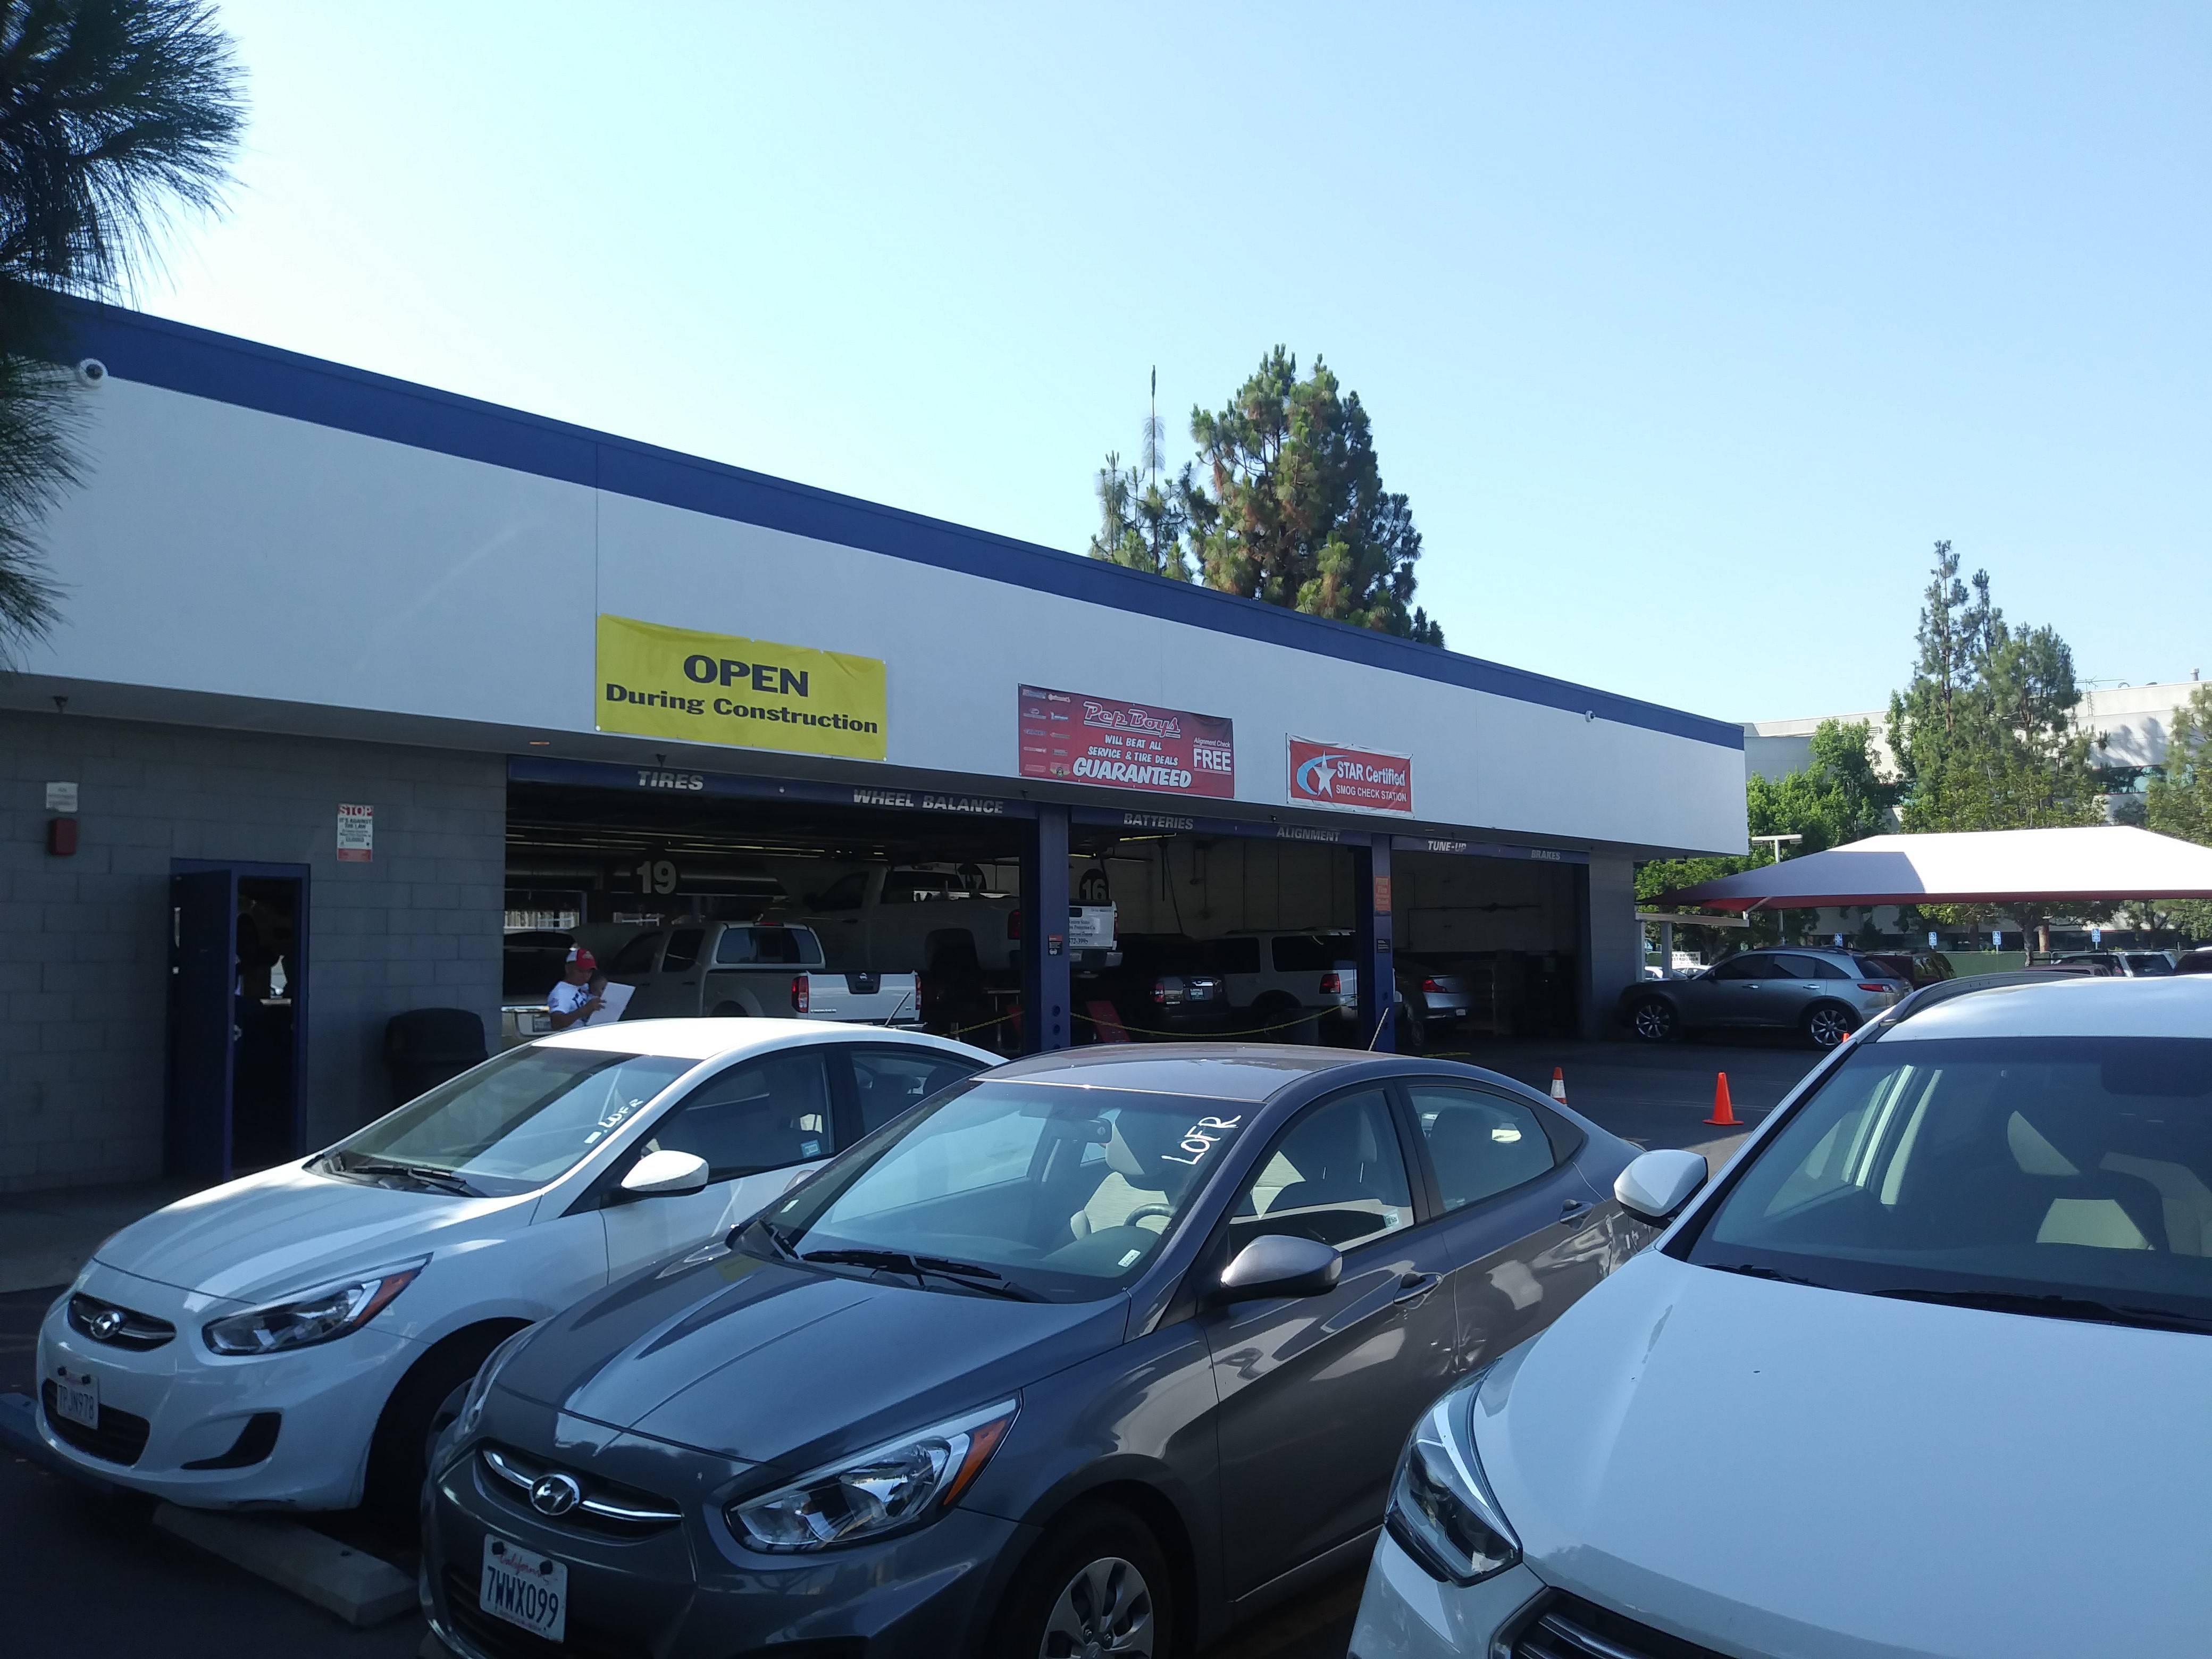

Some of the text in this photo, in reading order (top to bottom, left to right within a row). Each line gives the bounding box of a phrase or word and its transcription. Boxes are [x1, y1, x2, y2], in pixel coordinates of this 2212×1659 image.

[684, 655, 808, 697] OPEN
[606, 683, 877, 734] During Construction
[1083, 701, 1180, 738] Pep Boys
[1105, 734, 1162, 750] WILL BEAT ALL
[1194, 737, 1217, 746] Alignment
[1087, 746, 1178, 766] SERVICE & TIRE DEALS
[1193, 748, 1231, 772] FREE
[638, 771, 704, 790] TIRES
[1073, 757, 1192, 788] GUARANTEED
[1337, 760, 1405, 787] STAR Certified
[853, 789, 1004, 814] WHEEL BALANCE
[1336, 784, 1407, 802] SMOG CHECK STATION
[338, 804, 373, 816] STOP
[1124, 813, 1193, 830] BATTERIES
[1277, 826, 1340, 842] ALIGNMENT
[1428, 841, 1467, 852] TUNE-UP
[1531, 850, 1561, 860] BRAKES
[636, 860, 677, 894] 19
[1082, 878, 1106, 899] 16
[1161, 1115, 1242, 1164] LOFR
[488, 1565, 559, 1628] 7WWX099
